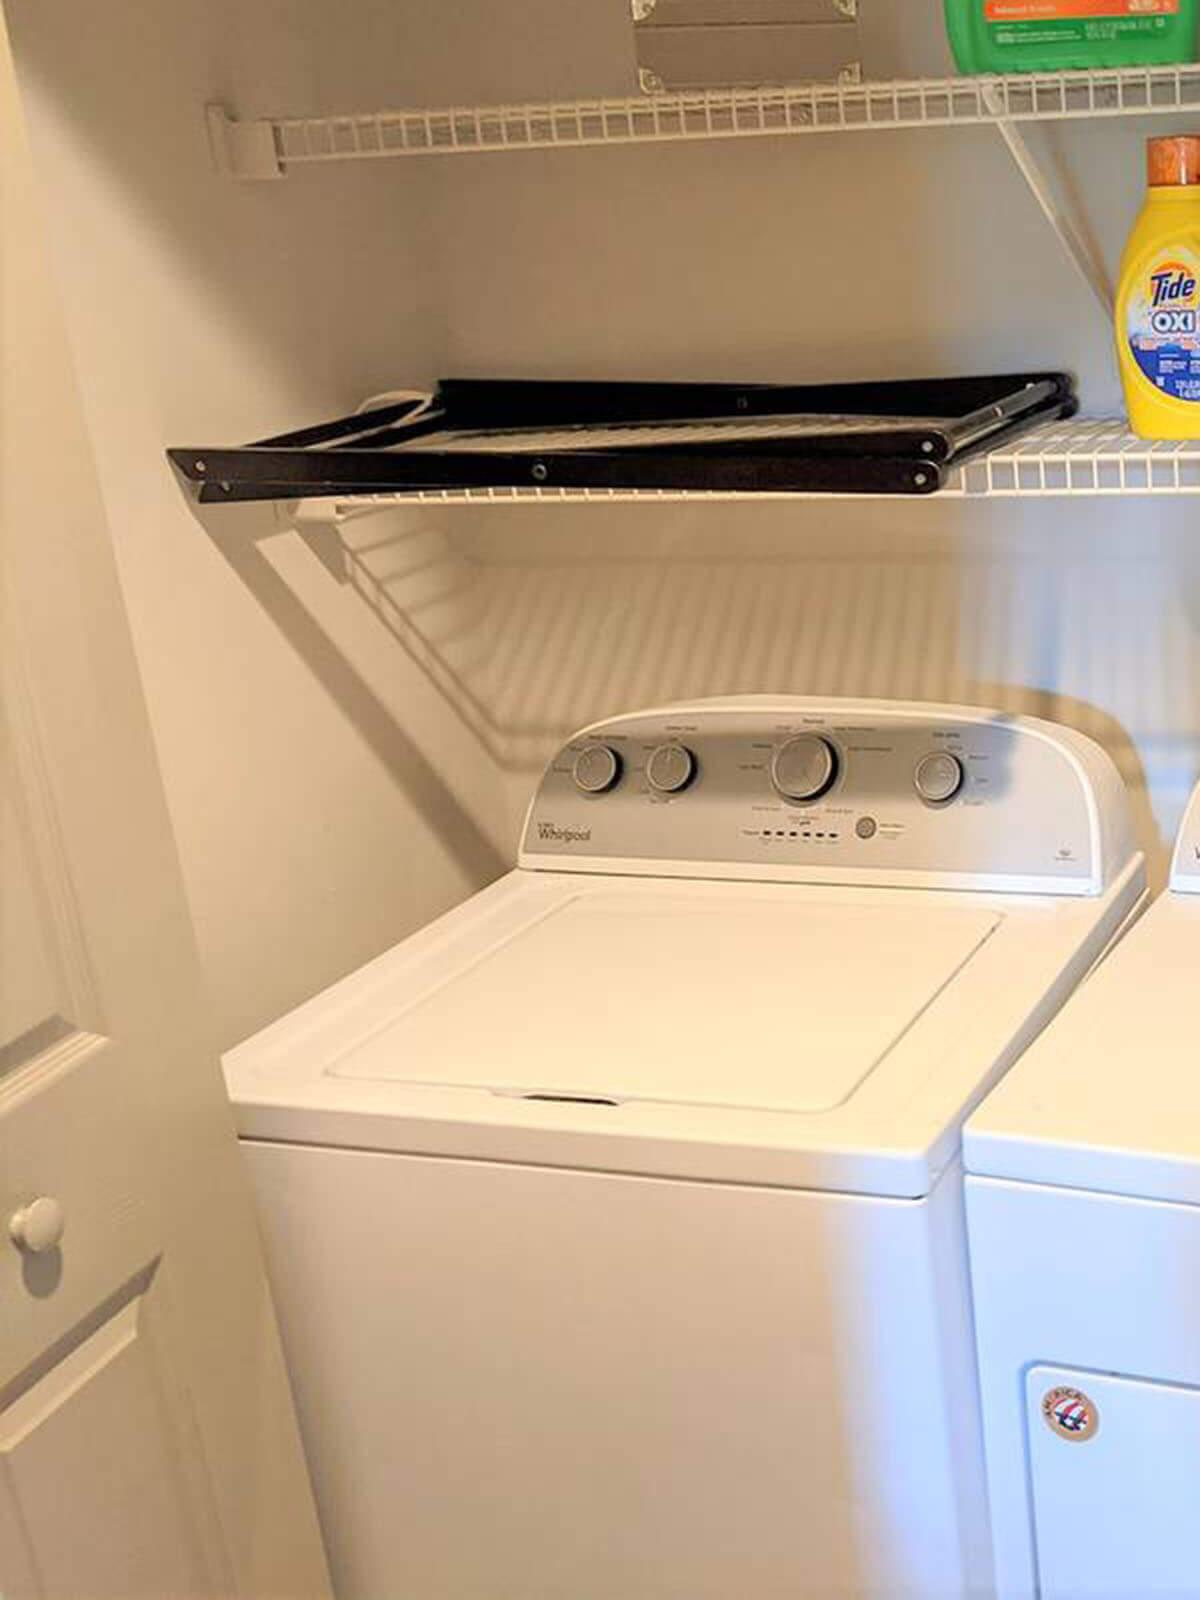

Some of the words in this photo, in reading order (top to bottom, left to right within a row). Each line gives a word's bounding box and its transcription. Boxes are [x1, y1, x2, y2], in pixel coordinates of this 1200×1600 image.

[1151, 271, 1196, 307] Tide
[1152, 310, 1196, 333] OXI
[538, 825, 591, 843] Whirlpool
